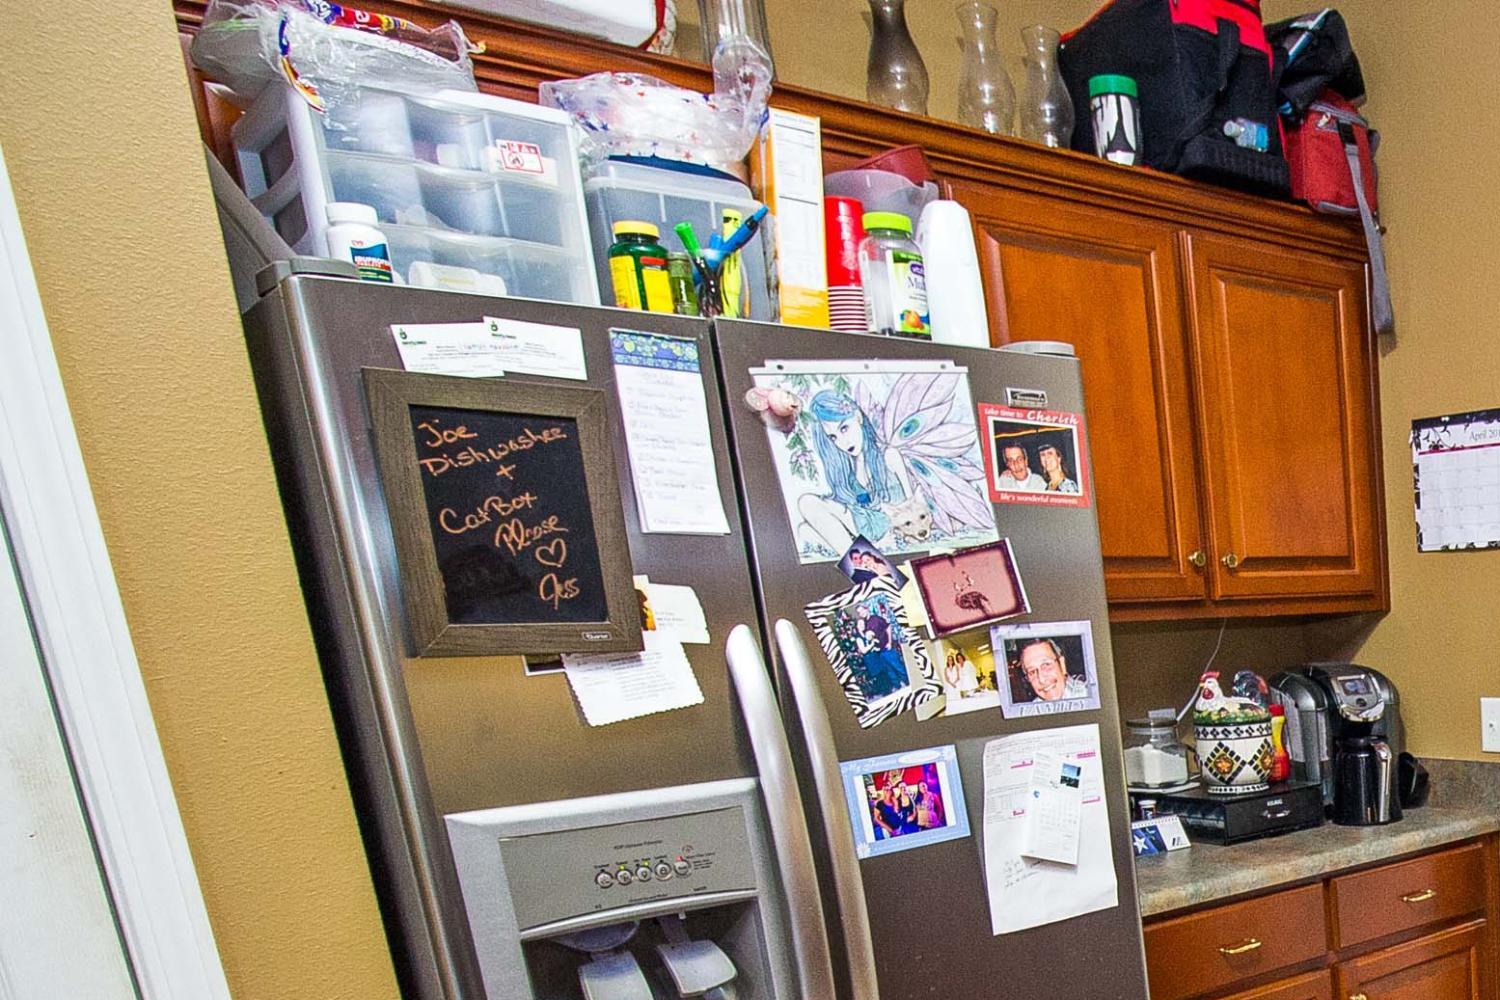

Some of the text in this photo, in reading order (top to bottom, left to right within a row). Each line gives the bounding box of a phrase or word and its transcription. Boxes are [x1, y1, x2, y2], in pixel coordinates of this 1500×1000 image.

[1026, 410, 1079, 425] Cherish
[418, 419, 479, 447] Joe
[1469, 428, 1487, 441] April
